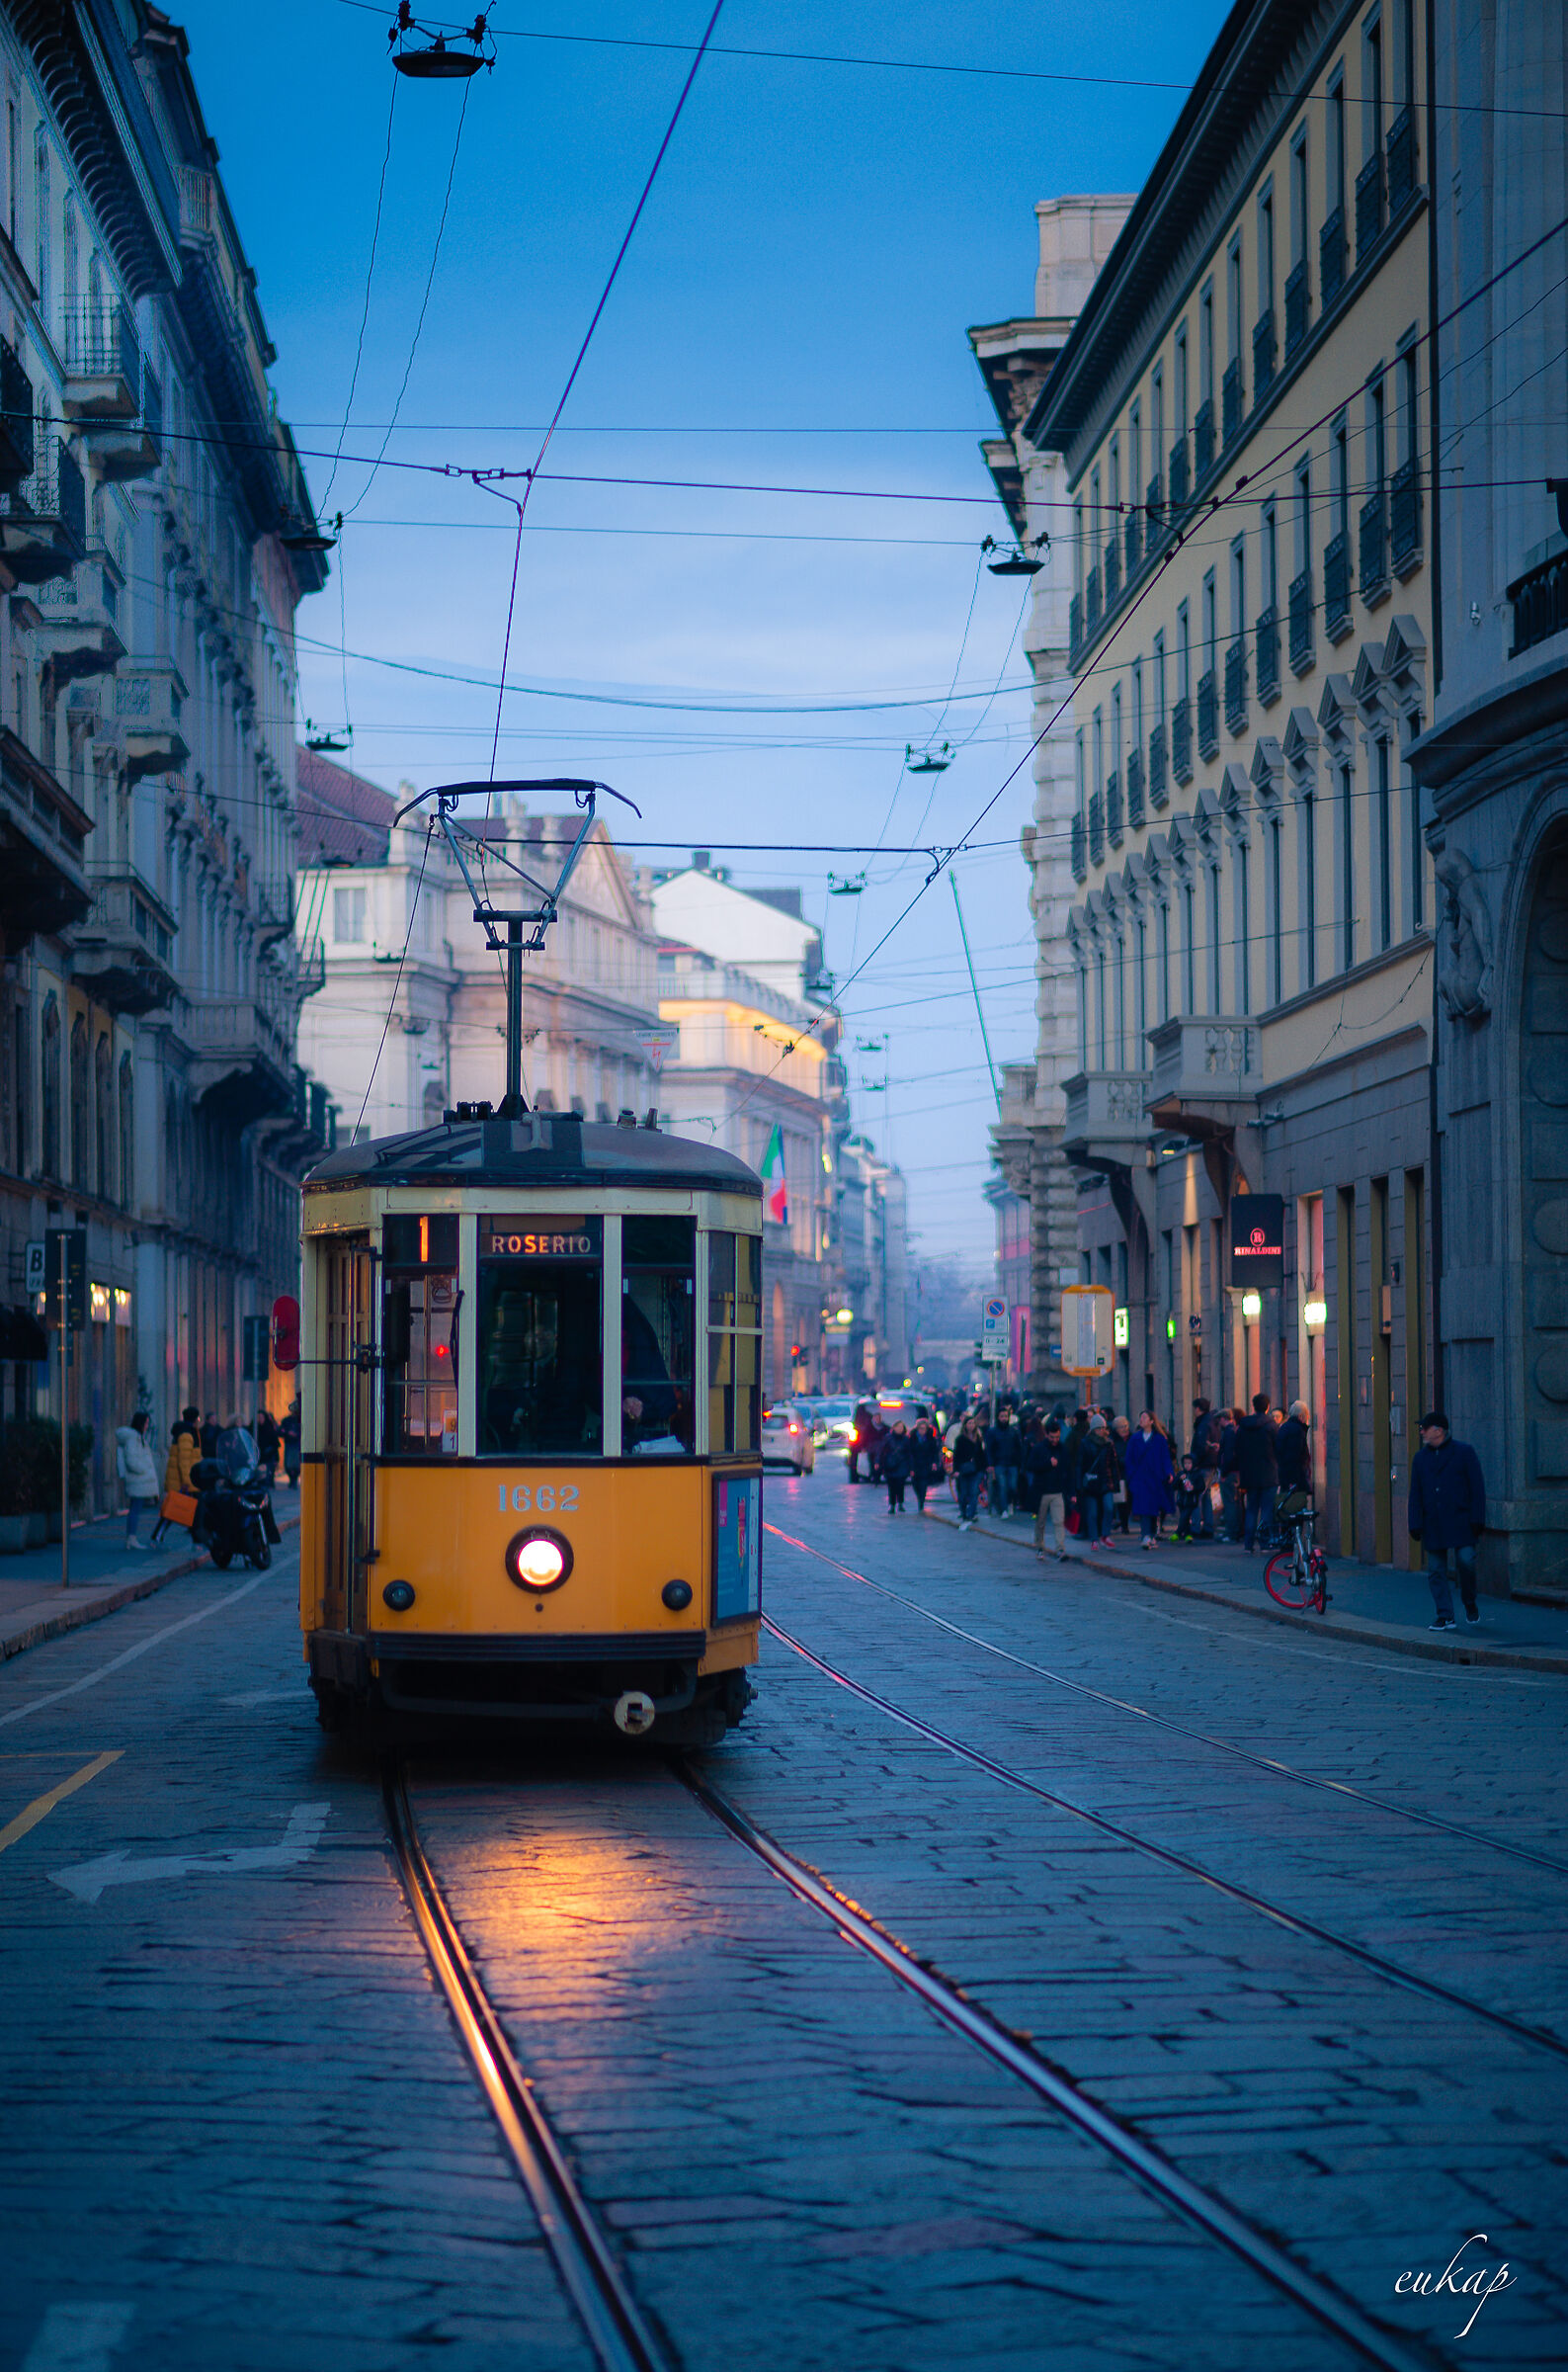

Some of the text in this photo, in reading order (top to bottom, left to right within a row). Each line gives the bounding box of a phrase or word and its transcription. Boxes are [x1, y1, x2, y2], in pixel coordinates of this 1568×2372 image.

[419, 1216, 429, 1262] 1
[491, 1234, 591, 1254] ROSERIO
[1233, 1246, 1282, 1256] RINALDINI
[498, 1484, 579, 1511] 1662
